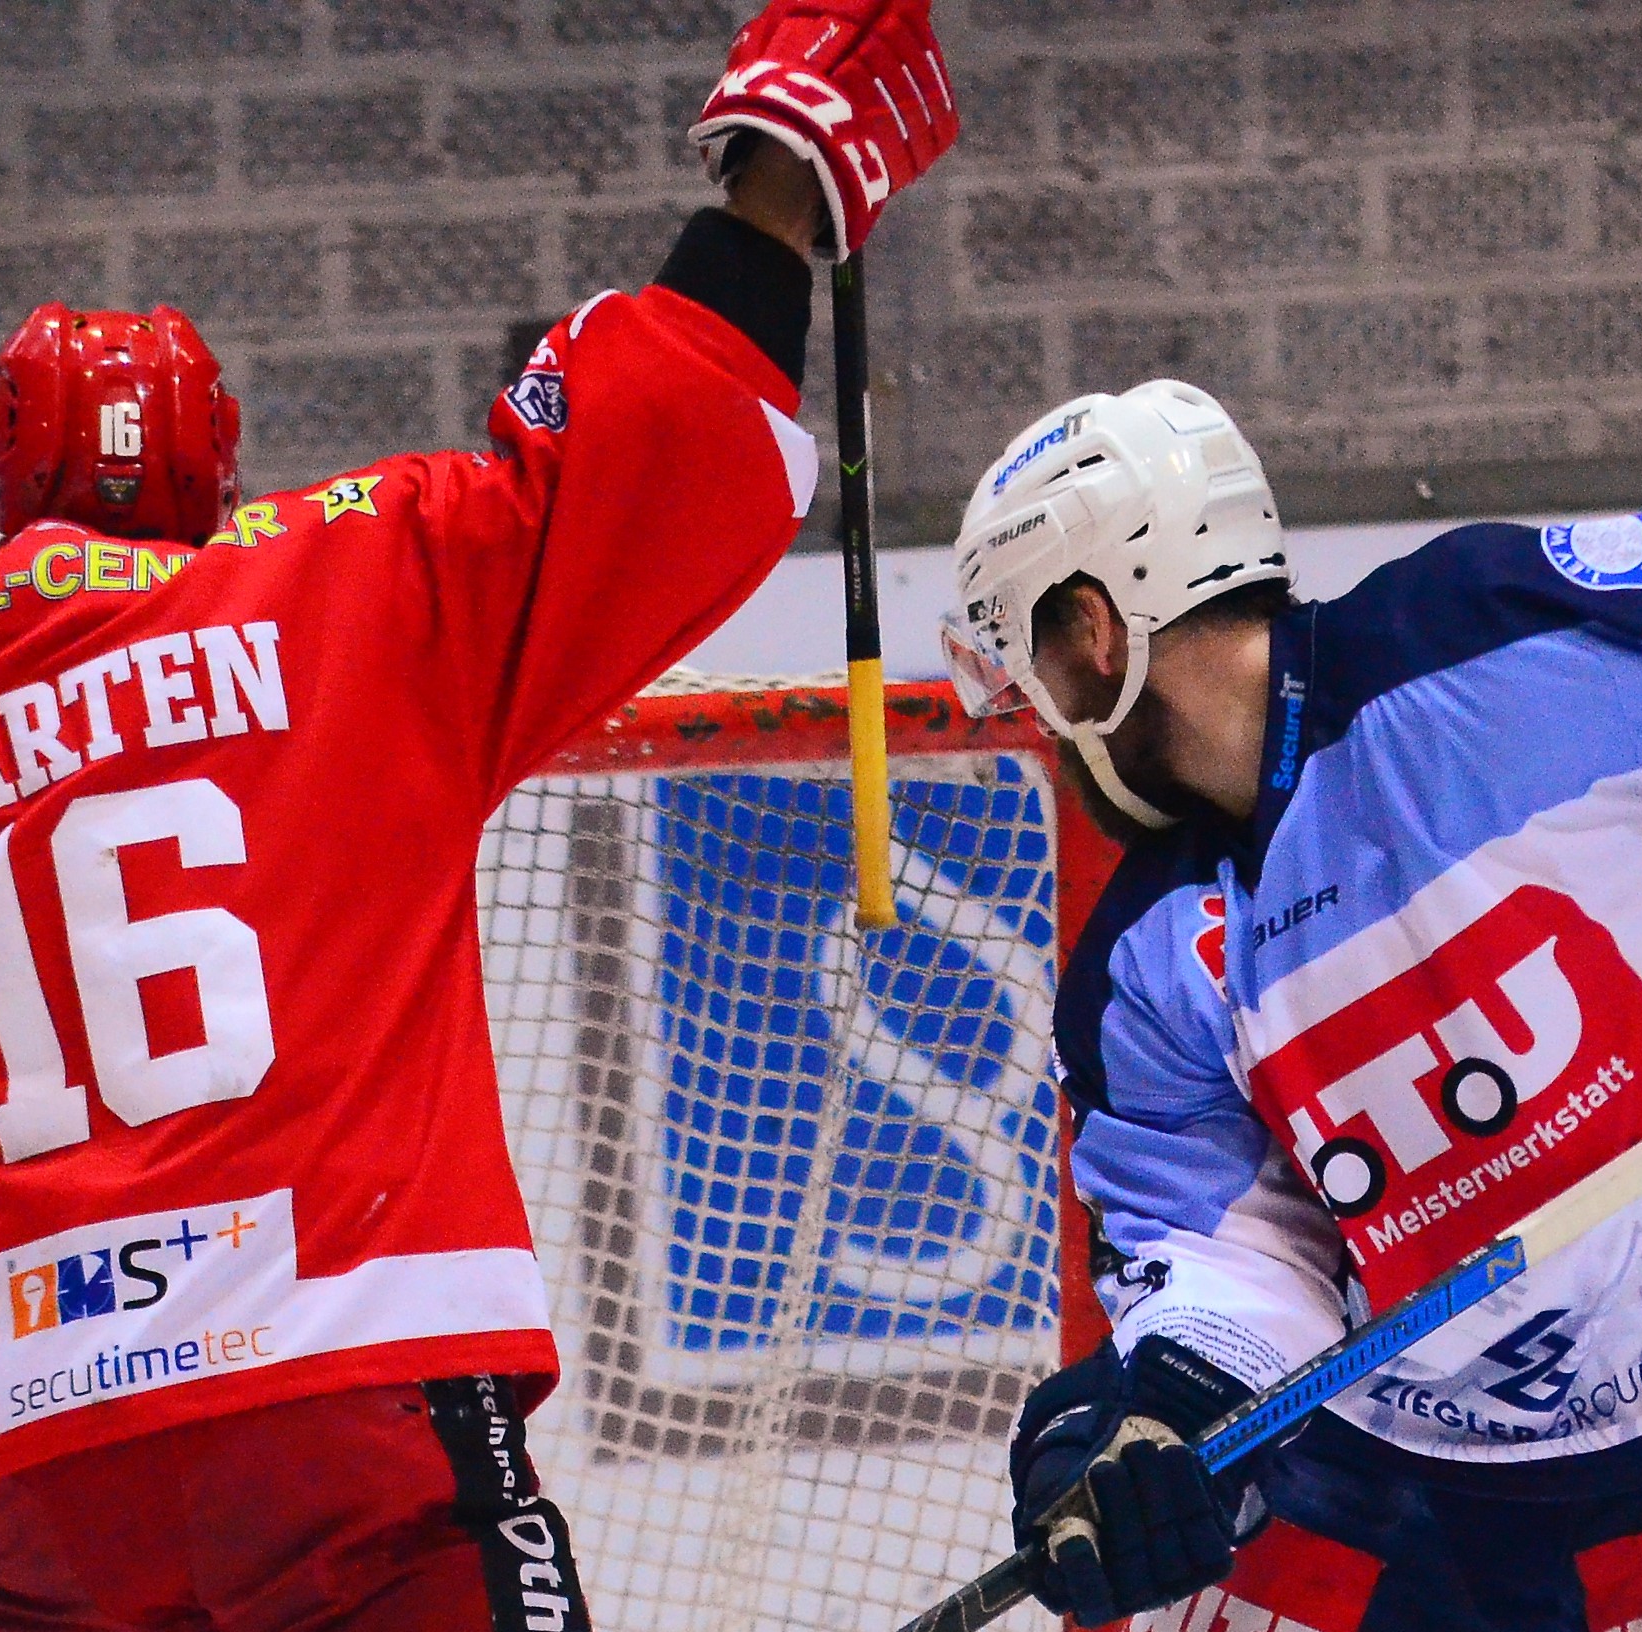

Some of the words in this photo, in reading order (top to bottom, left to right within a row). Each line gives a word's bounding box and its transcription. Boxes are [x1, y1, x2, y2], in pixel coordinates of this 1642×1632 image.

[100, 402, 142, 457] 16
[1365, 1055, 1635, 1254] Meisterwerkstatt
[10, 1326, 274, 1418] secutimetec
